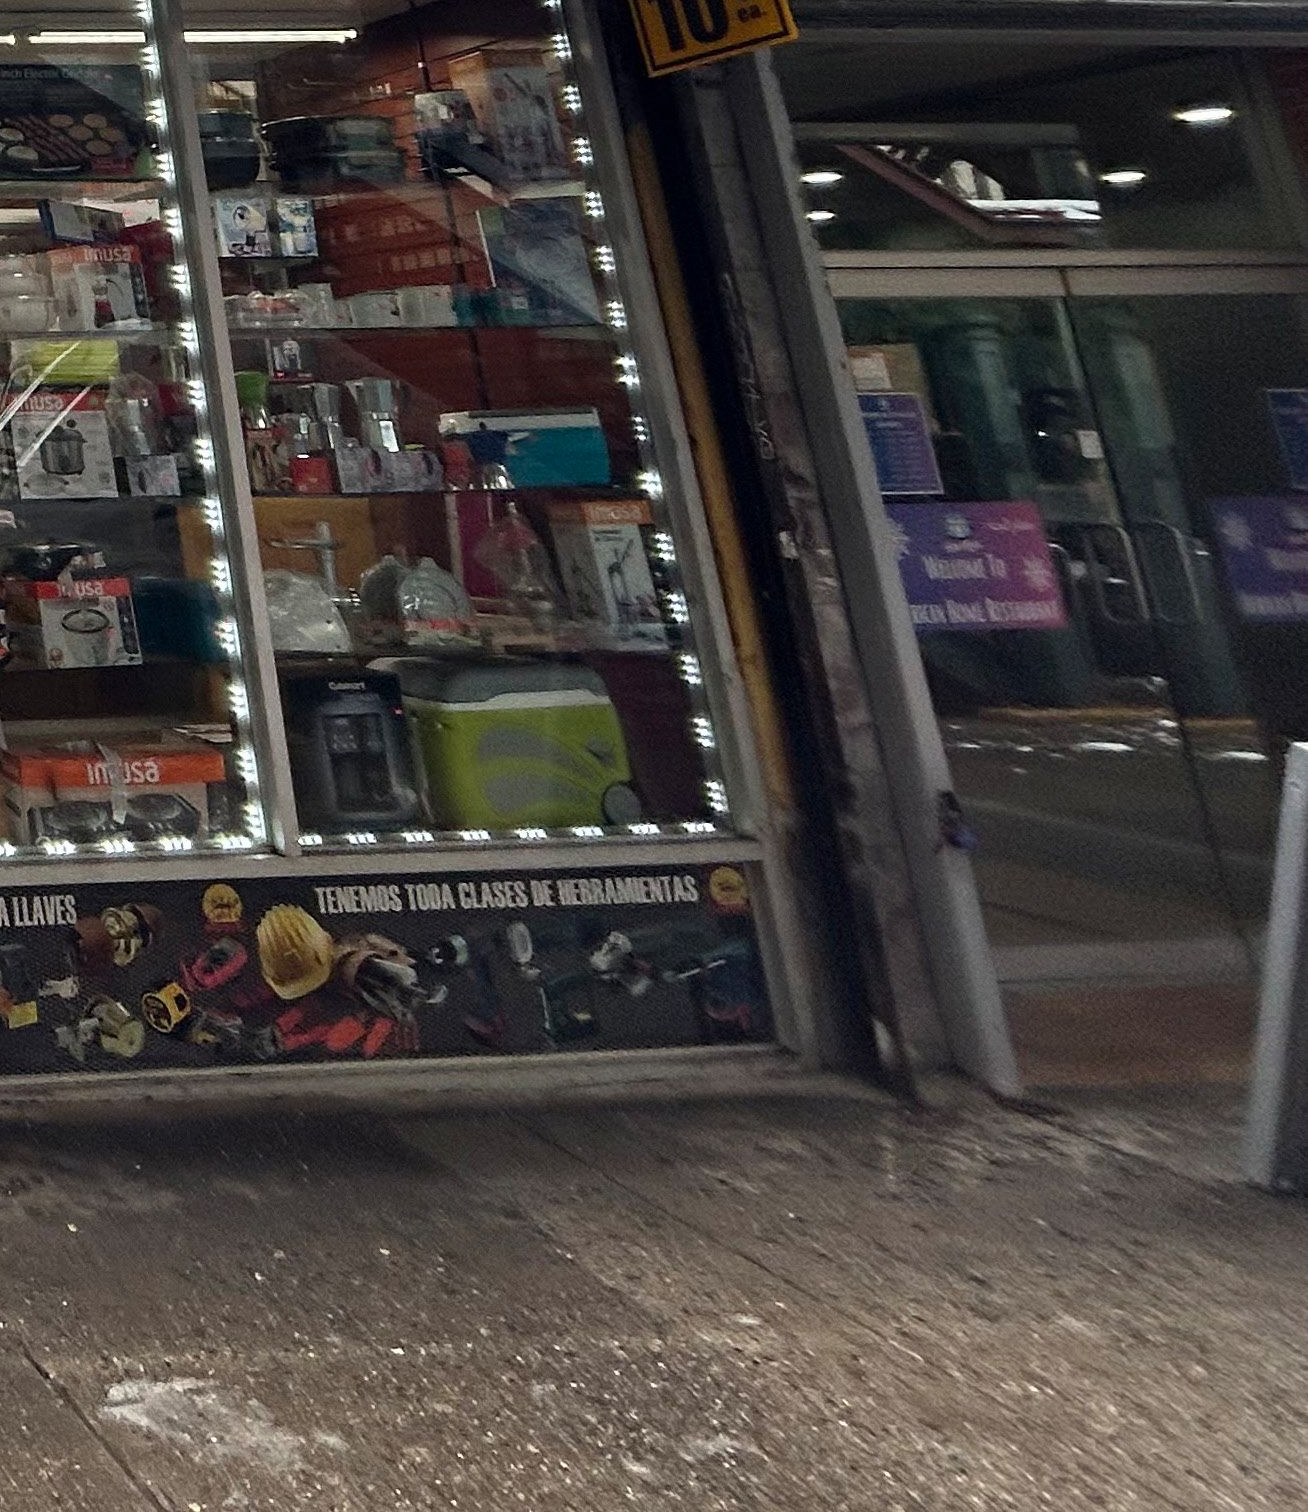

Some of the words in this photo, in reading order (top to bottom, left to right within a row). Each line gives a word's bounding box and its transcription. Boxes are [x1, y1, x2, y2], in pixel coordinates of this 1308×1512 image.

[12, 894, 77, 927] LLAVES
[314, 883, 403, 915] TENEMOS
[406, 882, 458, 912] TODA
[459, 879, 530, 910] CLASES
[530, 879, 556, 907] DE
